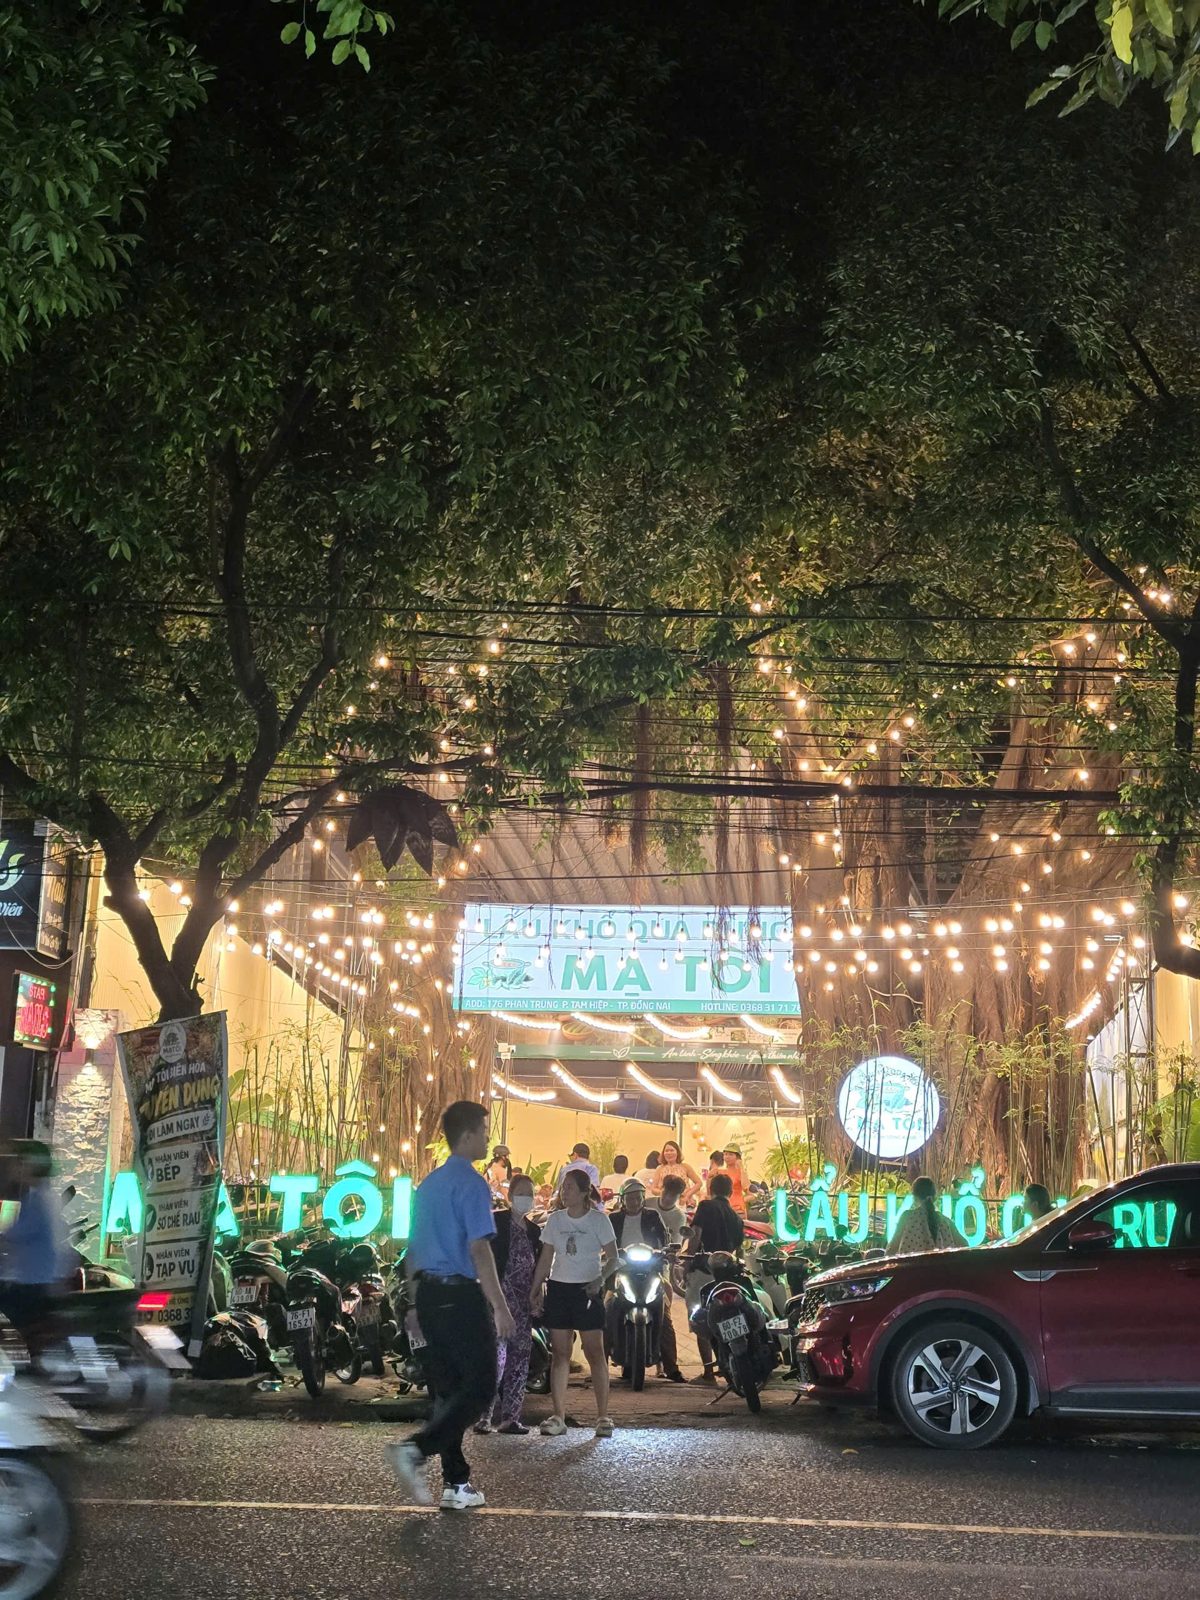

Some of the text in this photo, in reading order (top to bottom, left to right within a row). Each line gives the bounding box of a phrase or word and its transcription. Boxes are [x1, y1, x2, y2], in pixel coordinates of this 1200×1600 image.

[553, 911, 617, 940] KHỔ
[627, 919, 693, 943] QUA
[560, 947, 771, 997] MẠ TÔI
[487, 1000, 503, 1009] 176
[590, 1000, 609, 1011] HIỆP
[630, 999, 655, 1011] ĐỒNG
[656, 1001, 671, 1011] NAI
[741, 1002, 762, 1012] 0368
[764, 1002, 775, 1012] 31
[778, 1002, 789, 1012] 71
[156, 1121, 174, 1138] LÀM
[176, 1116, 200, 1132] NGAY
[173, 1150, 190, 1161] VIÊN
[156, 1160, 181, 1182] BẾP
[269, 1160, 412, 1239] TÔI
[776, 1164, 869, 1244] LẨU
[167, 1210, 180, 1229] CHẾ
[182, 1211, 200, 1227] RAU
[156, 1248, 190, 1260] NHÂN VIÊN
[156, 1260, 195, 1281] TẠP VỤ
[157, 1309, 181, 1322] 0368
